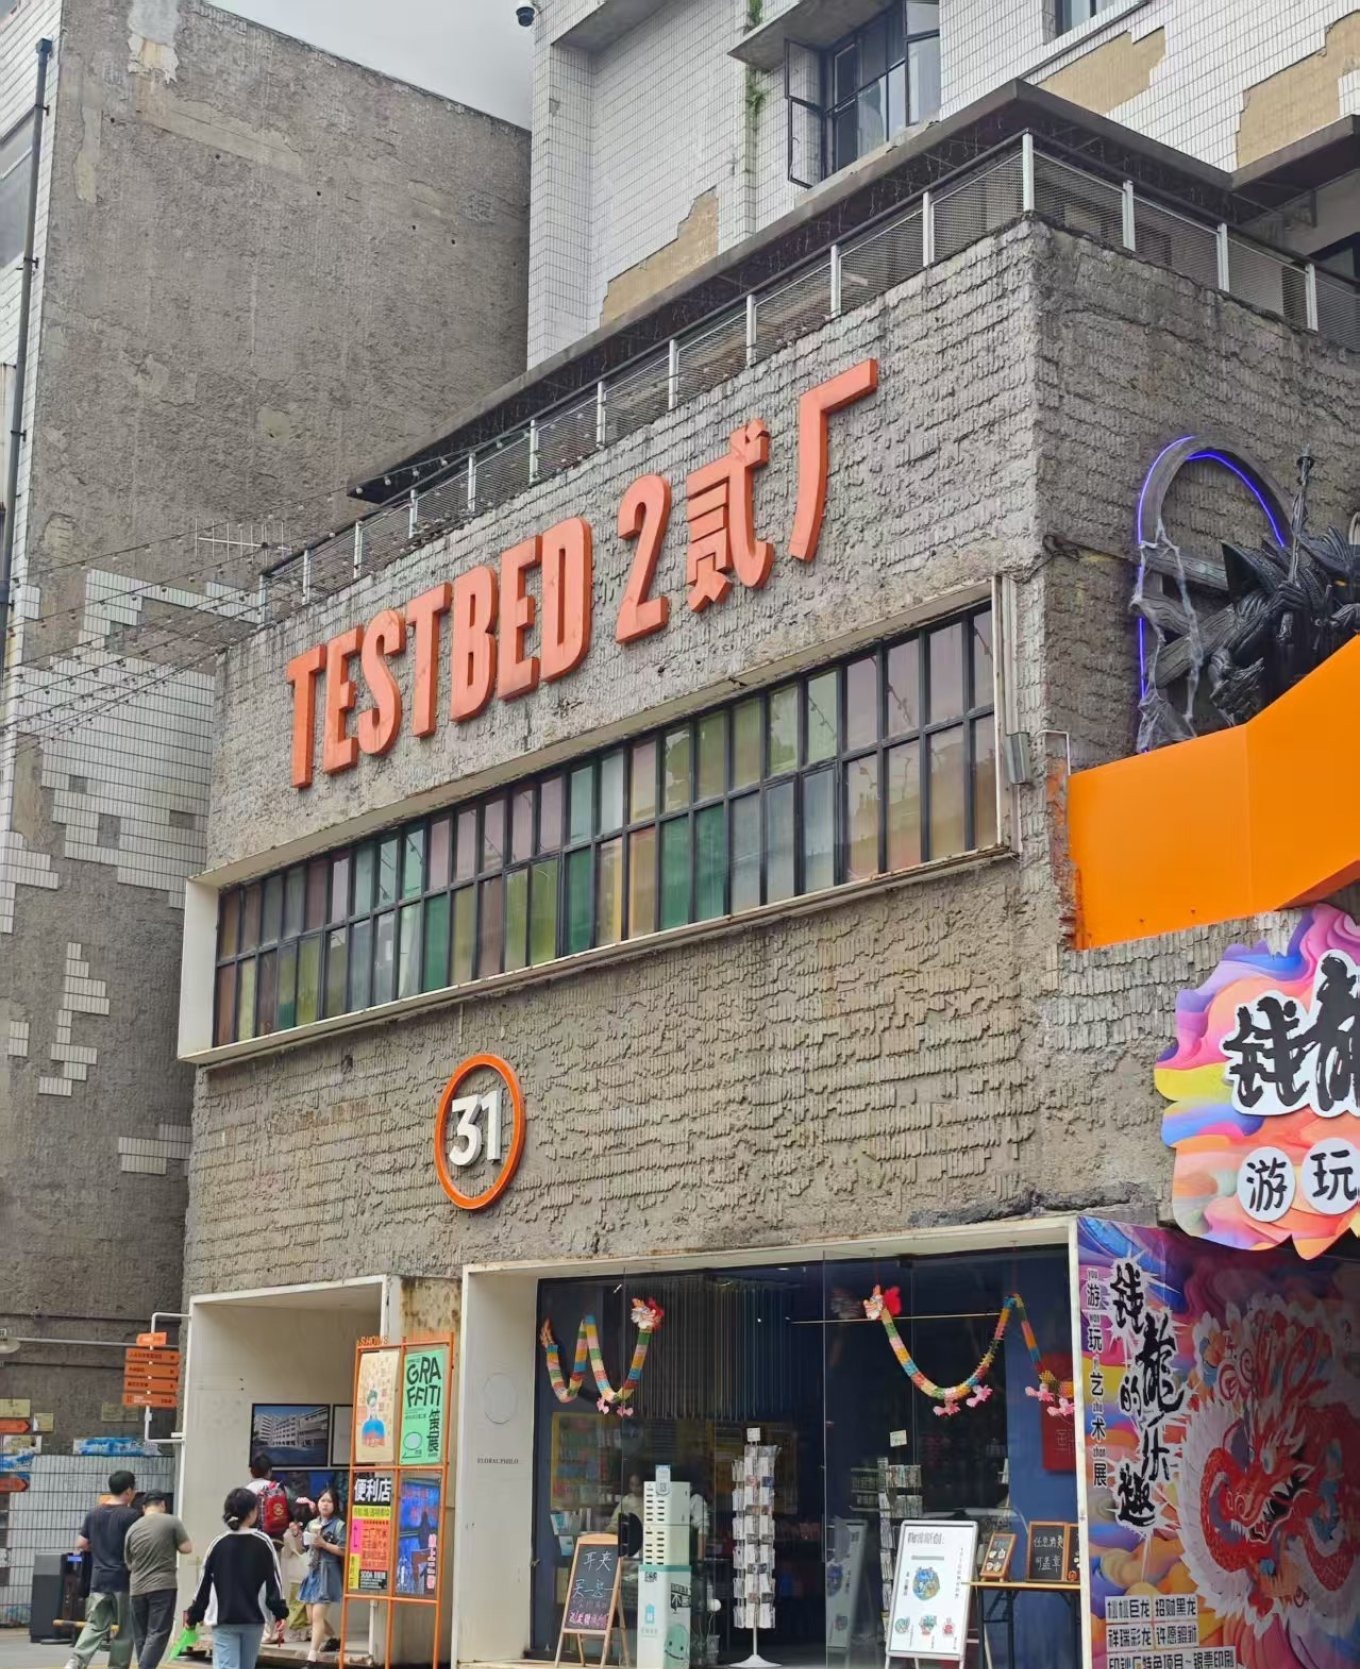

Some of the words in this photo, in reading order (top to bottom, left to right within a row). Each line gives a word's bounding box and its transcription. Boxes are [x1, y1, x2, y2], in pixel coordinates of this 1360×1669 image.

[286, 517, 593, 789] TESTBED
[449, 1090, 503, 1167] 31
[407, 1356, 441, 1385] GRA
[406, 1385, 441, 1408] FFITI
[354, 1479, 391, 1502] 便利店
[1155, 1597, 1197, 1617] 招财黑龙
